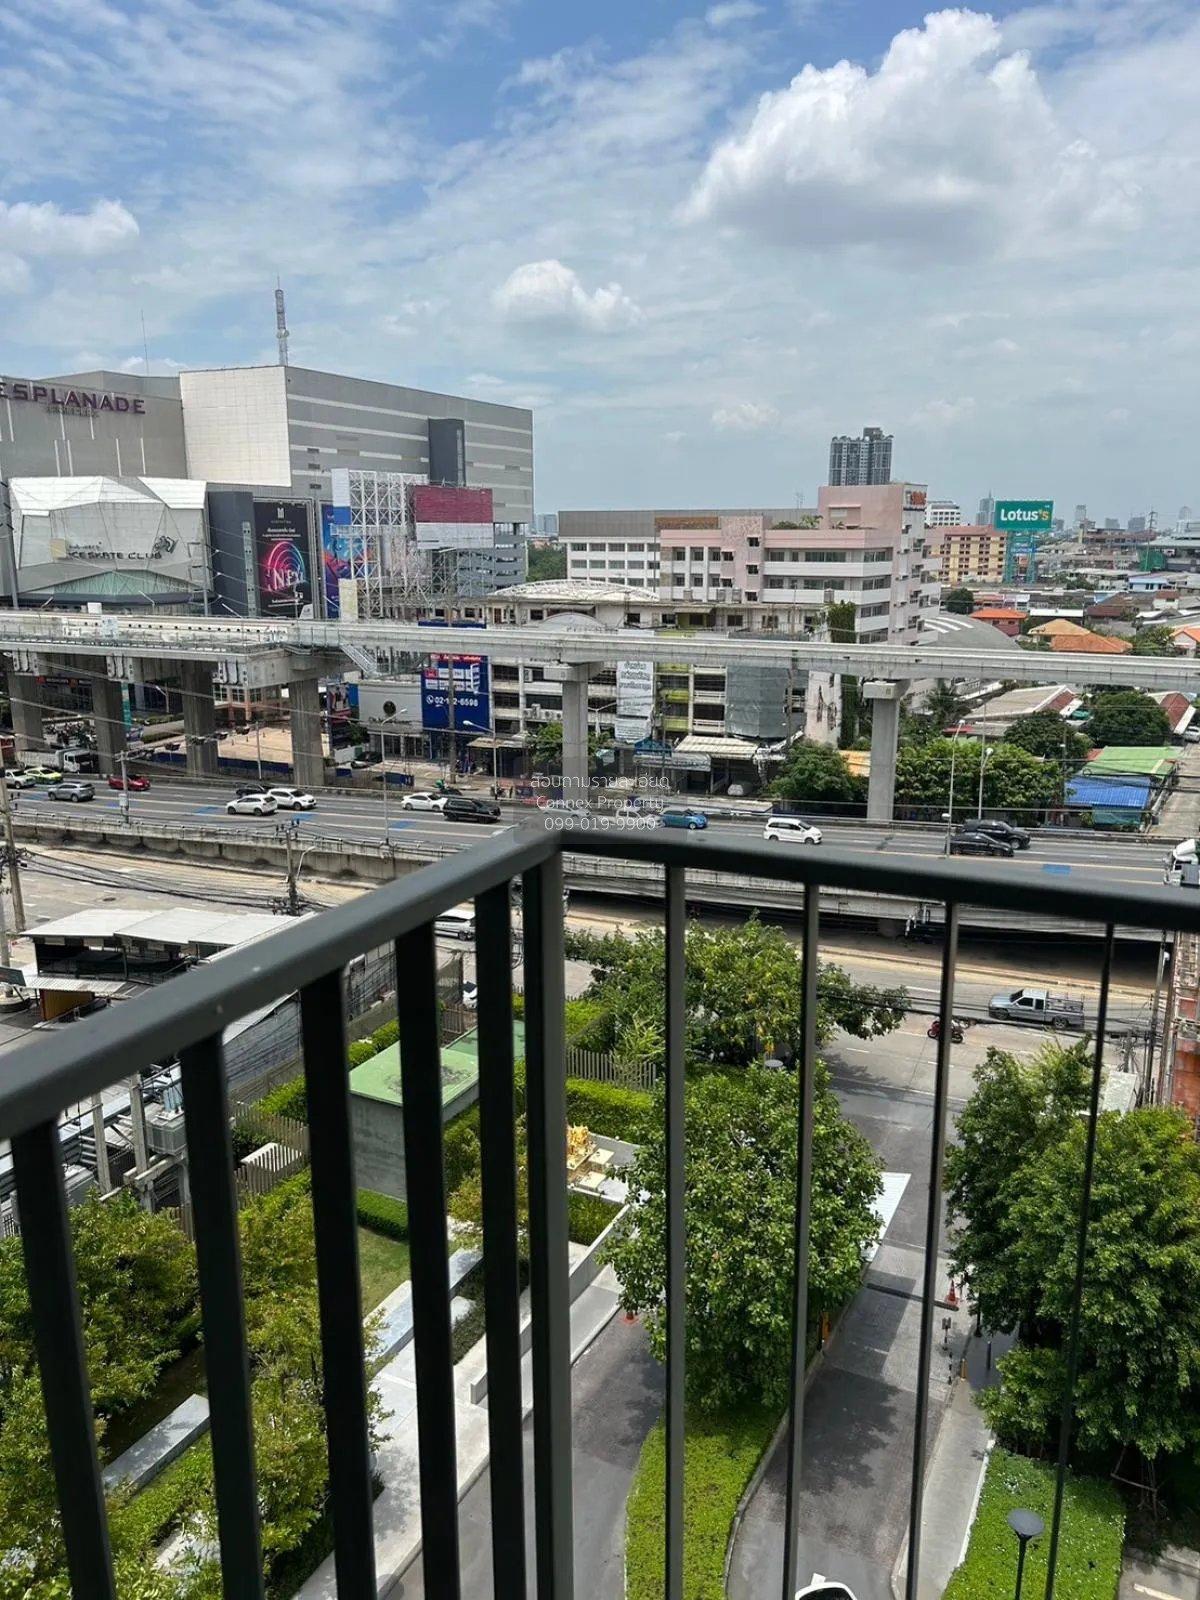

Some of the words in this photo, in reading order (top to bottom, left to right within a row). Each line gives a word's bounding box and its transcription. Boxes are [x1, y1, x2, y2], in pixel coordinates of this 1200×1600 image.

[0, 382, 146, 414] ESPLANADE
[1000, 508, 1049, 521] Lotus's
[434, 696, 479, 707] 02-12-6598
